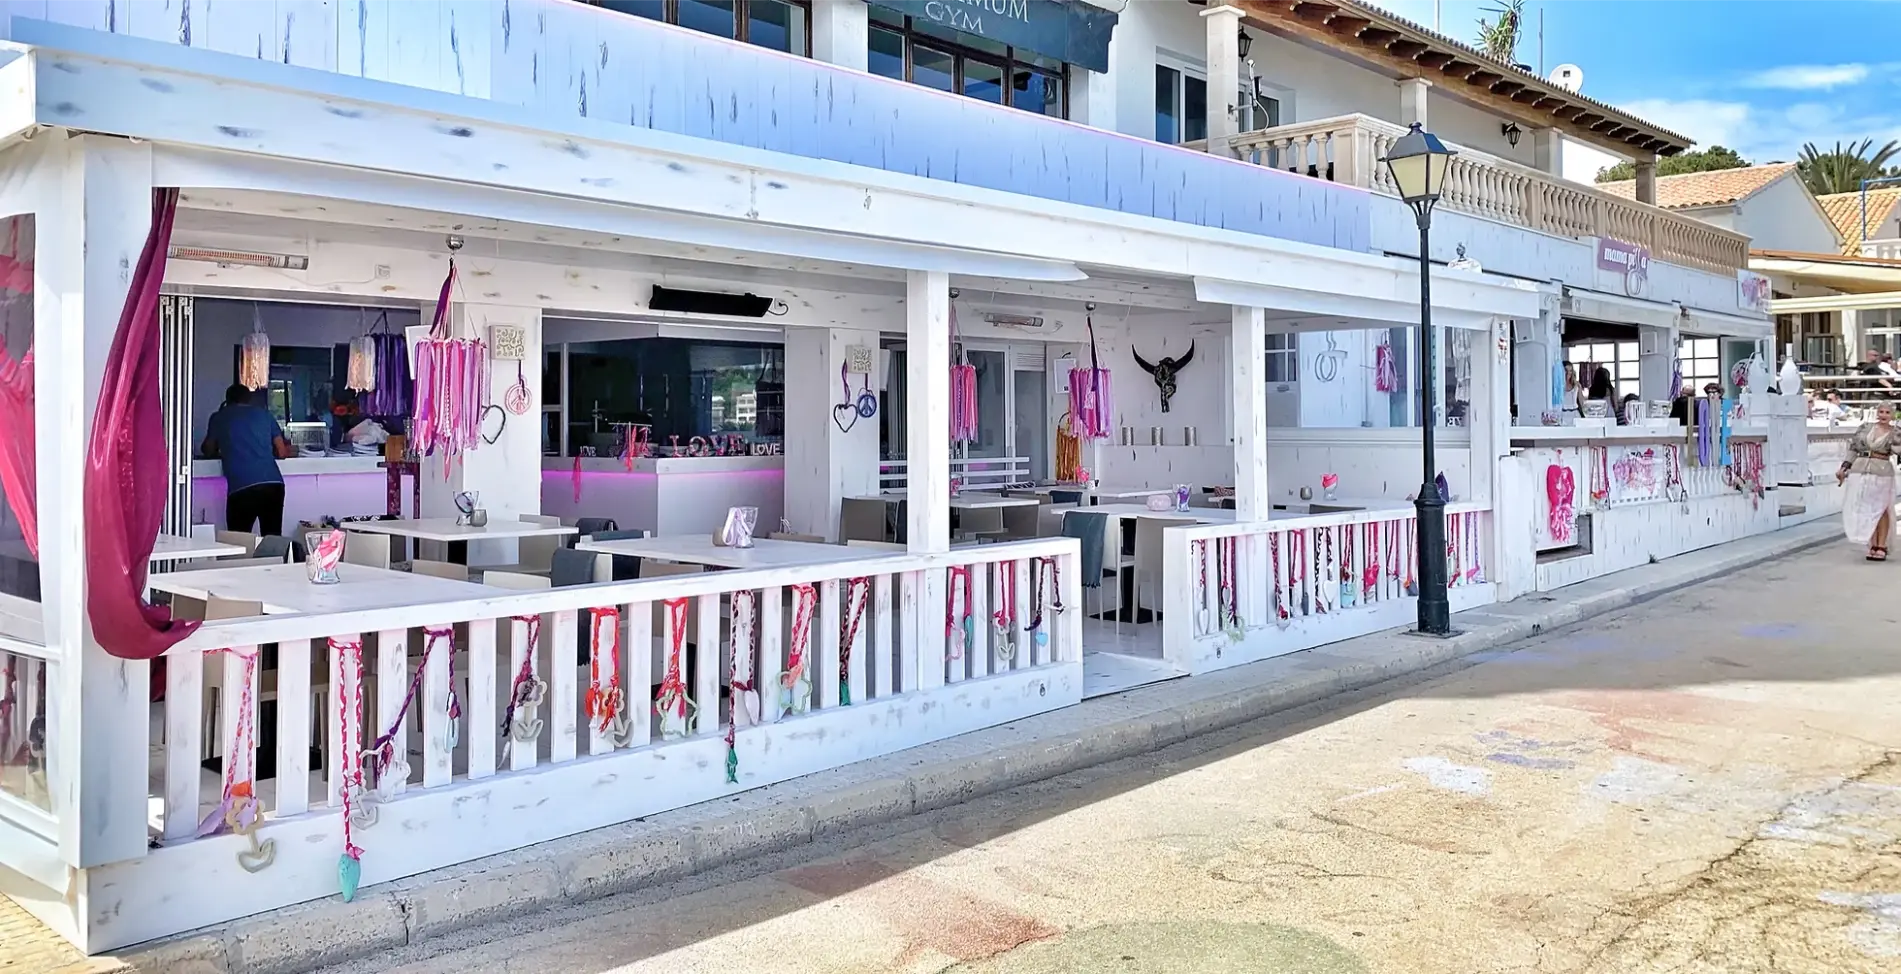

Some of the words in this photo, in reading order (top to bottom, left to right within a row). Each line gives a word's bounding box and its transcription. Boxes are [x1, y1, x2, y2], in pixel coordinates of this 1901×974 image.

[925, 1, 984, 34] GYM
[957, 0, 1030, 24] UM
[668, 434, 746, 458] LOVE
[751, 442, 781, 456] LOVE
